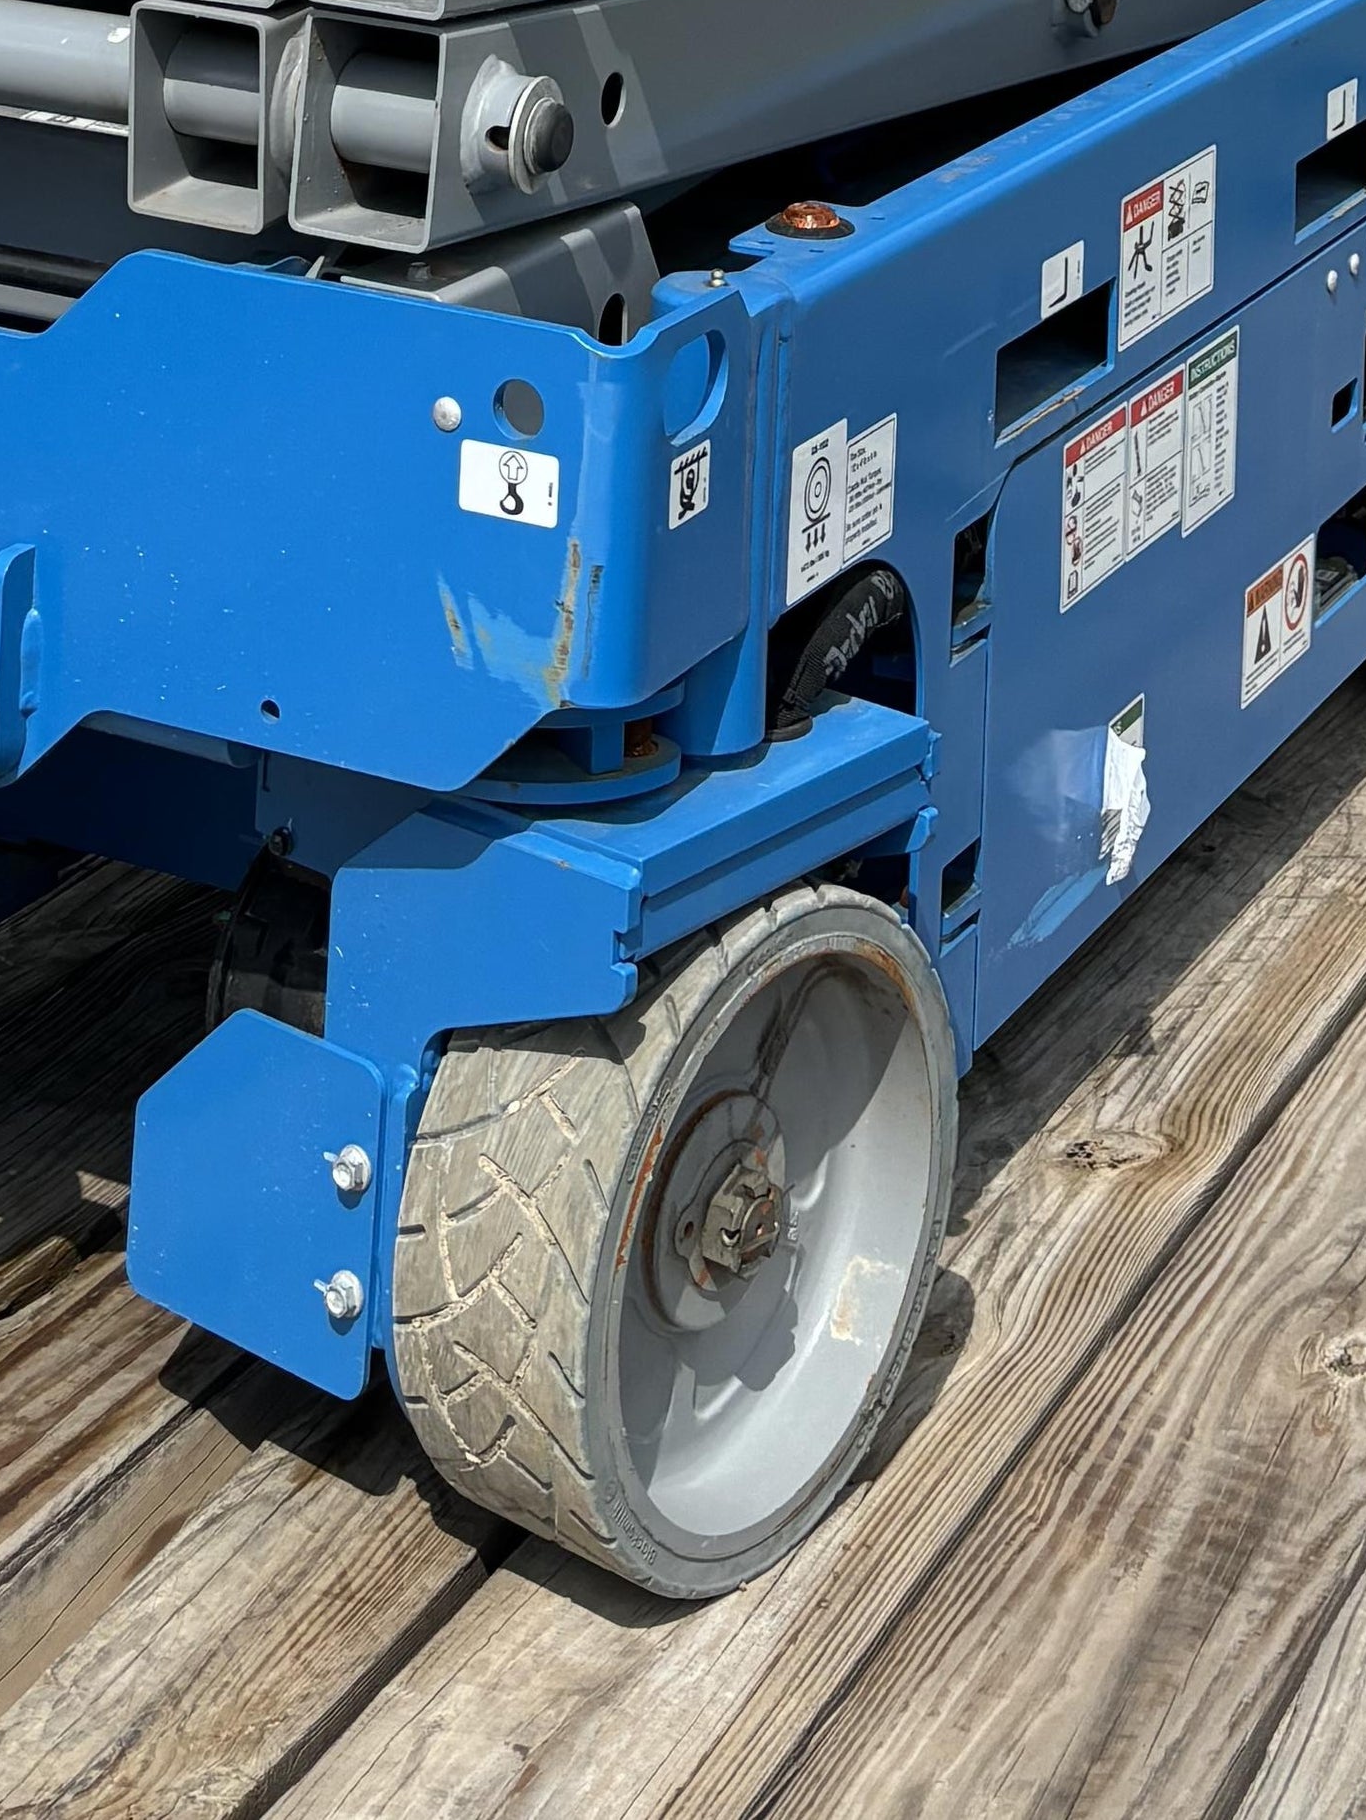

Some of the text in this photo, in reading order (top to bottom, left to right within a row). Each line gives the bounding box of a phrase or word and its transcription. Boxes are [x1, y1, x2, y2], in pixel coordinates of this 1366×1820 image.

[1132, 190, 1162, 219] DANGER
[1147, 379, 1176, 412] DANGER
[1085, 421, 1115, 452] DANGER
